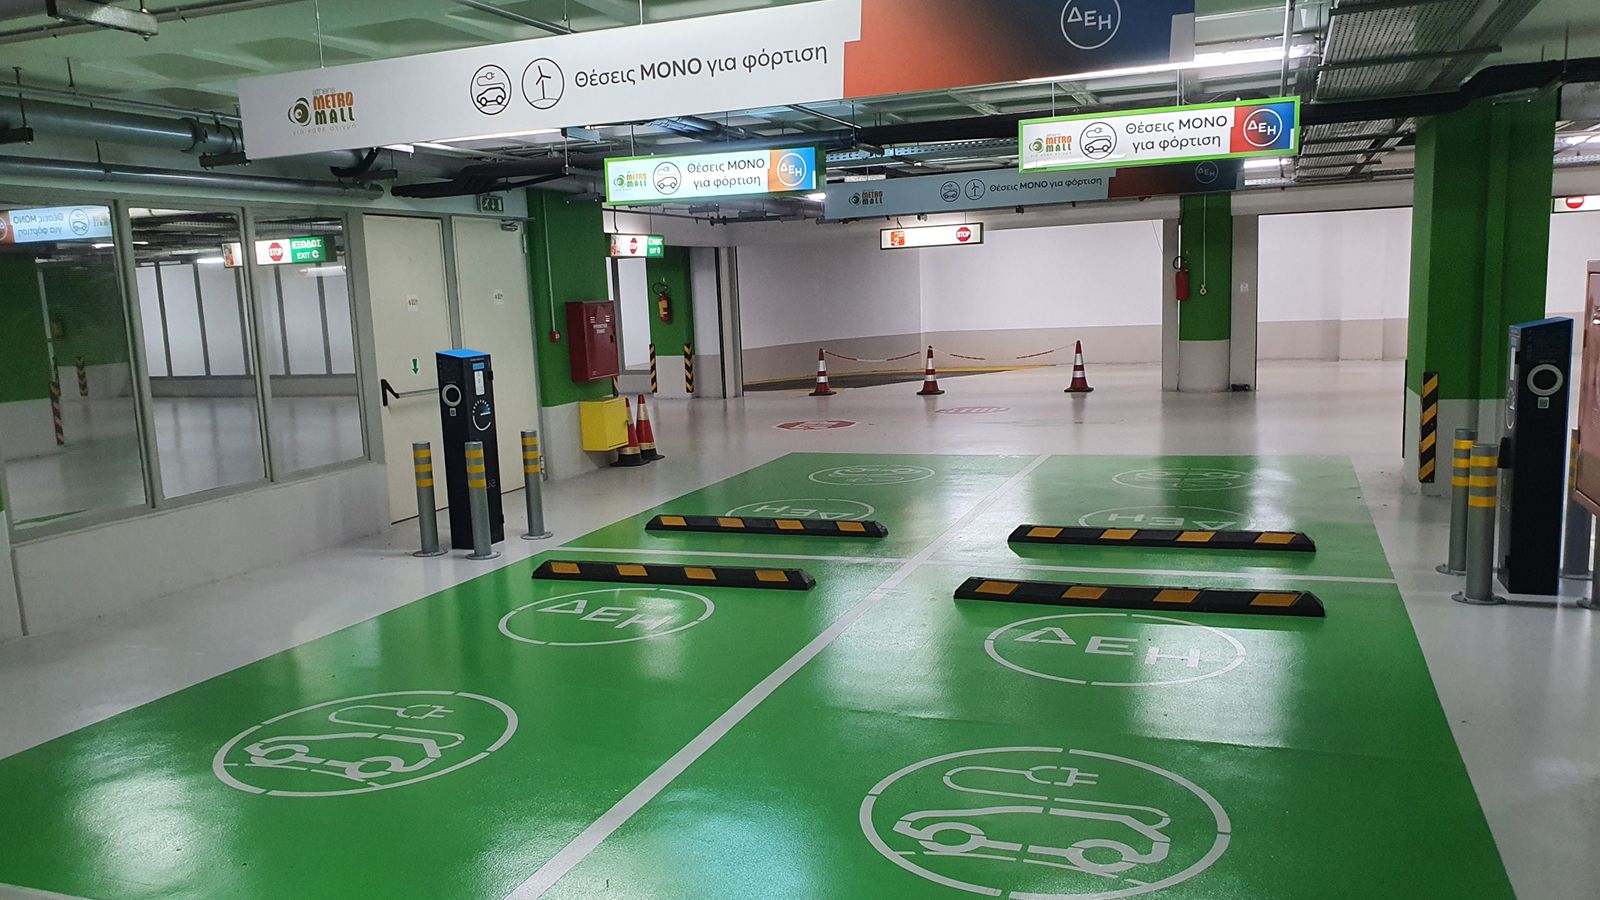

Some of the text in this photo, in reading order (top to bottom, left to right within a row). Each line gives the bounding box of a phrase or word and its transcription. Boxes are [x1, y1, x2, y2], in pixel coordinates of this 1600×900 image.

[1067, 6, 1112, 31] ΔΕΗ
[574, 45, 828, 87] Θέσεις ΜΟΝΟ για φόρτιση
[313, 91, 354, 111] METRO
[314, 107, 355, 125] MALL
[1125, 115, 1228, 135] Θέσεις ΜΟΝΟ
[1247, 119, 1277, 136] ΔΕΗ
[1045, 135, 1072, 145] METRO
[1046, 143, 1072, 153] MALL
[1132, 135, 1221, 154] για φόρτιση
[687, 158, 765, 174] Θέσεις ΜΟΝΟ
[780, 161, 802, 177] ΔΕΗ
[693, 175, 761, 190] για φόρτιση
[989, 177, 1102, 193] Θέσεις ΜΟΝΟ για φόρτιση
[956, 230, 971, 239] STOP
[269, 247, 283, 257] STOP
[536, 599, 674, 631] ΔΕΗ
[1015, 626, 1202, 668] ΔΕΗ
